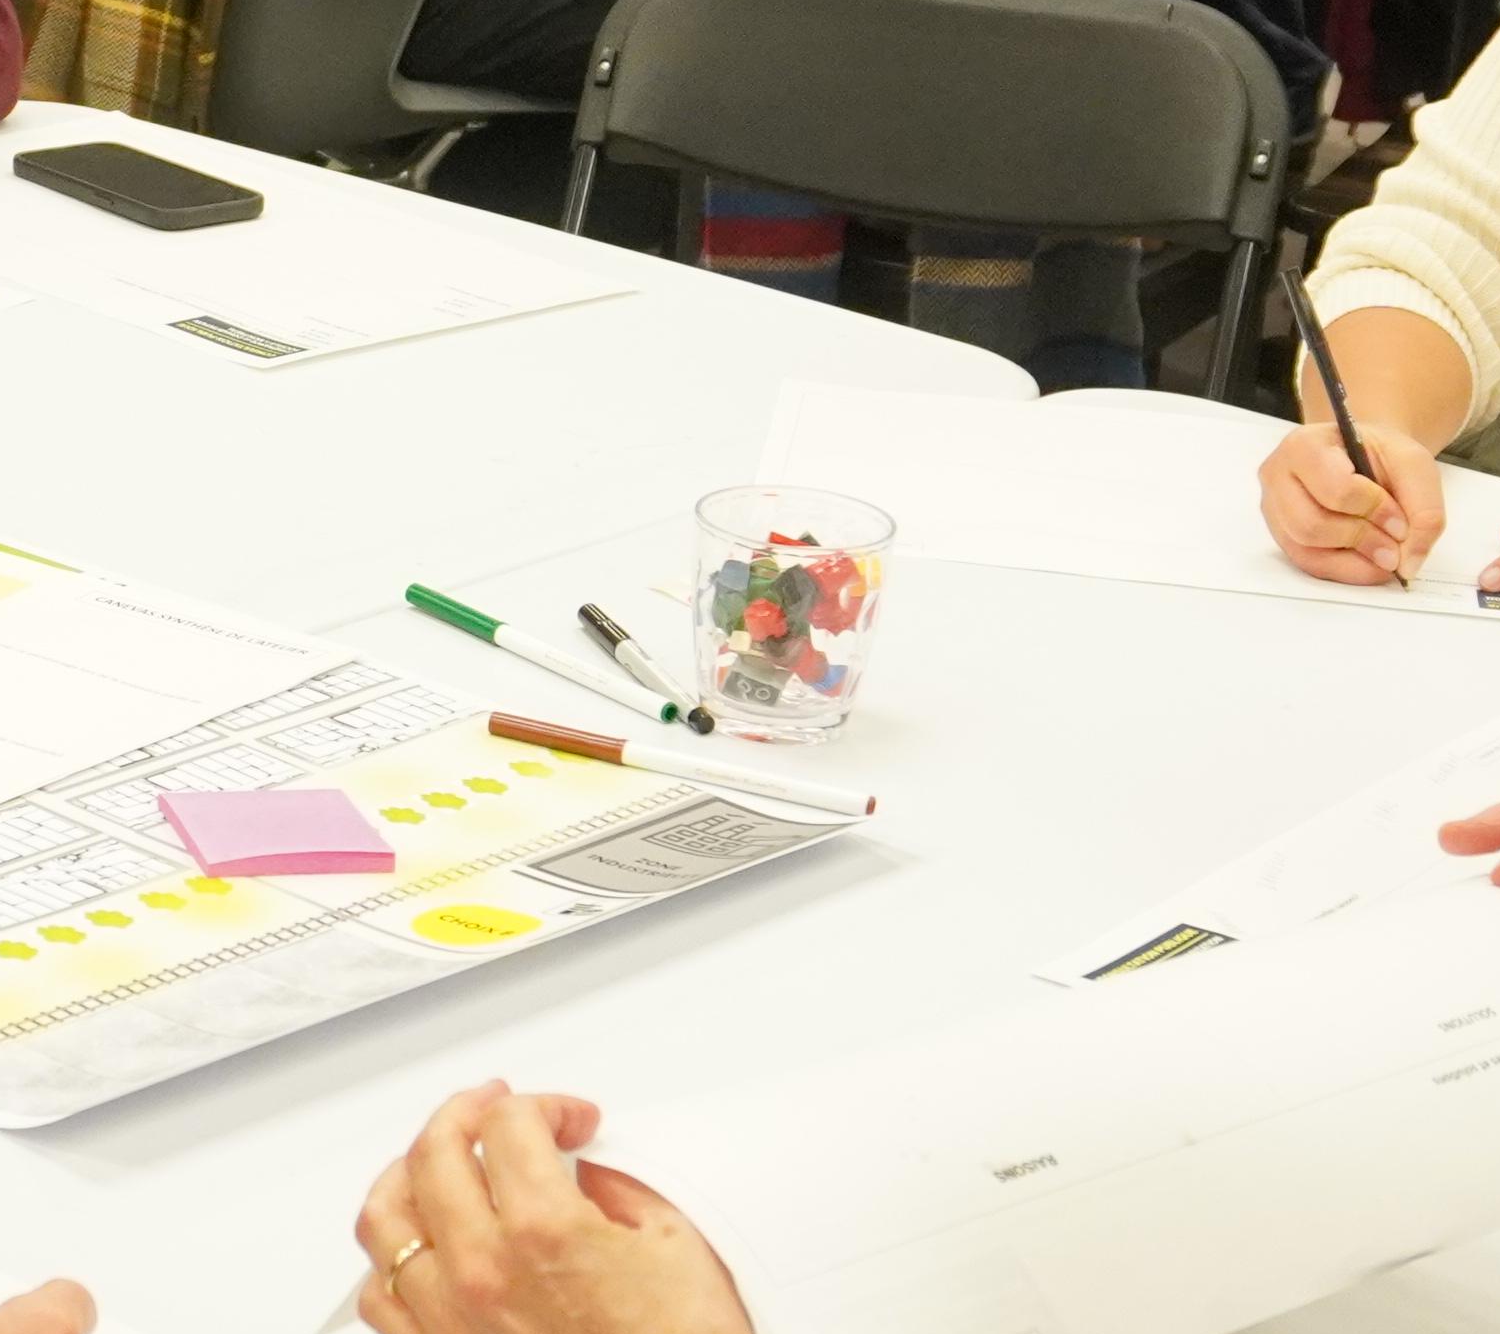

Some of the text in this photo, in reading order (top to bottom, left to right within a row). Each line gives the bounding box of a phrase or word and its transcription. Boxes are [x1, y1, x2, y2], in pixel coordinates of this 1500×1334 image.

[634, 857, 683, 871] ZONE
[439, 914, 495, 935] CHOIX
[992, 1153, 1059, 1184] RAISONS
